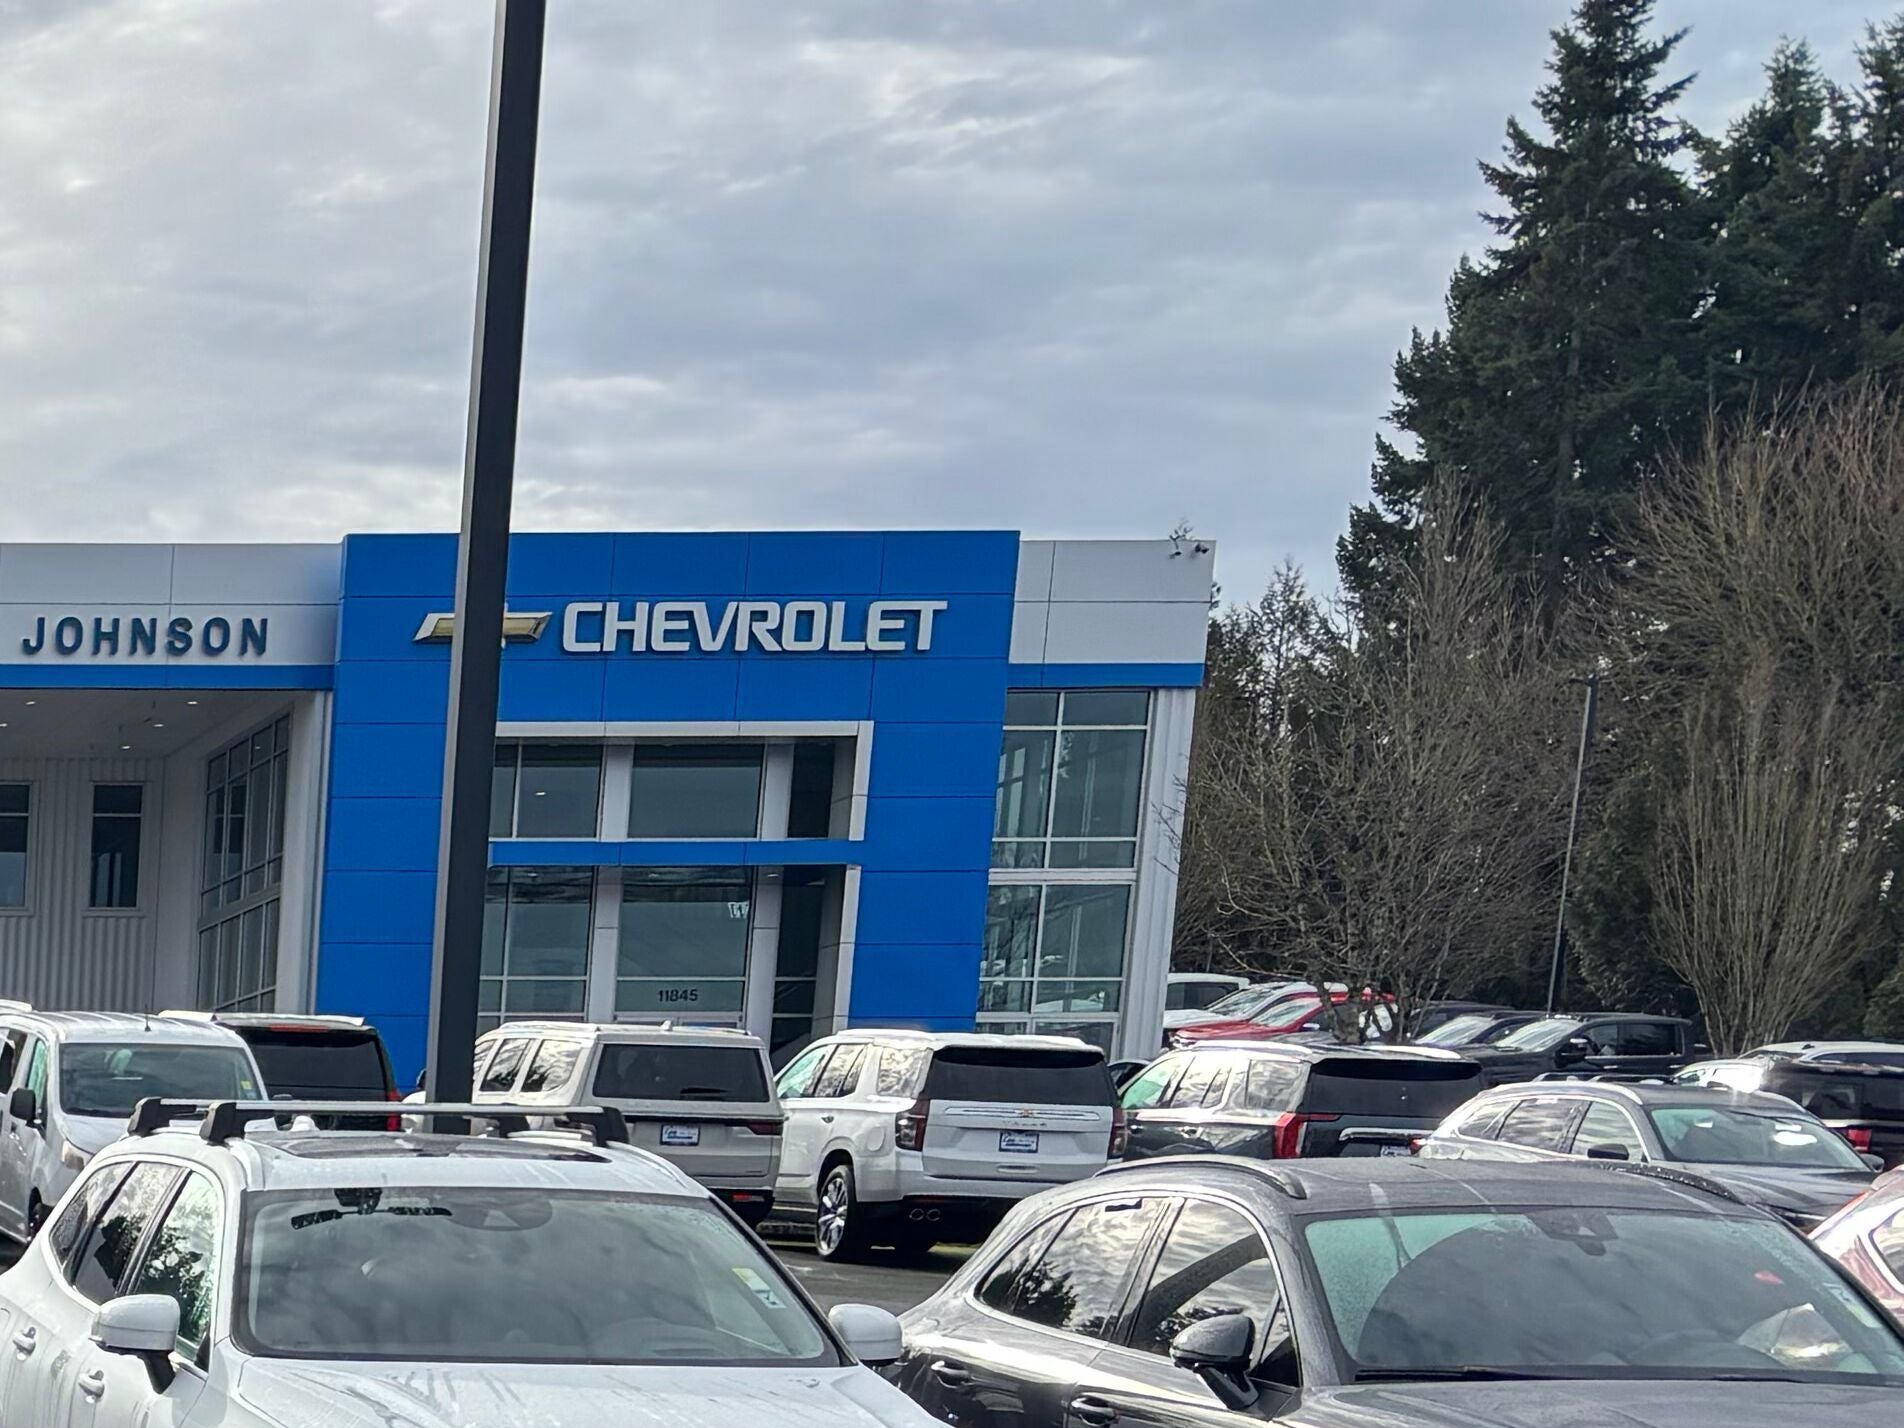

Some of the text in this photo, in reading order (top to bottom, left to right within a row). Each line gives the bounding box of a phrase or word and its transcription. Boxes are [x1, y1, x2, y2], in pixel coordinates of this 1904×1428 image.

[21, 616, 269, 657] JOHNSON
[562, 601, 948, 653] CHEVROLET
[657, 988, 699, 1002] 11845
